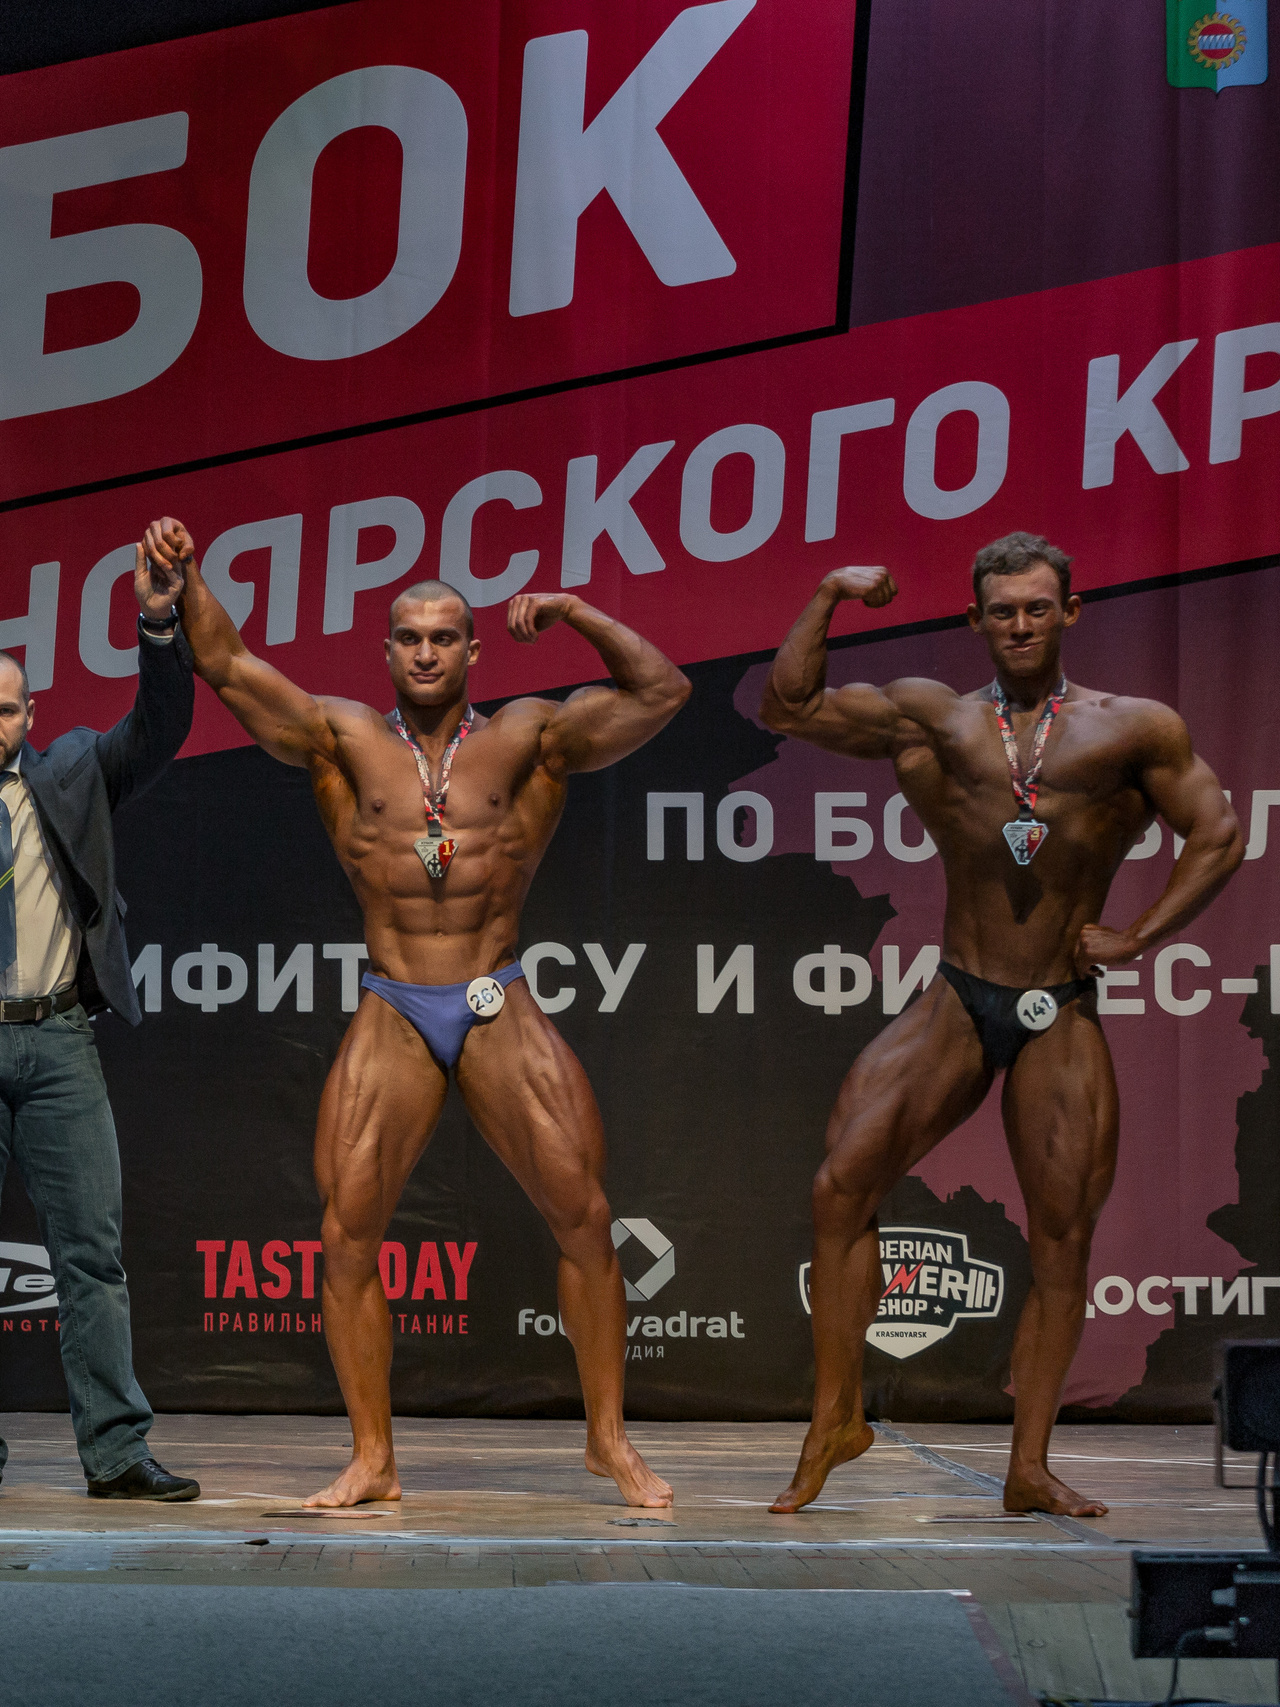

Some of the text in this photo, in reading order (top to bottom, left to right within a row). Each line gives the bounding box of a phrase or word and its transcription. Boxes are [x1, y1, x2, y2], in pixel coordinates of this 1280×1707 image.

[647, 790, 774, 862] ПО
[697, 944, 755, 1014] И
[470, 982, 503, 1012] 261
[1023, 996, 1053, 1023] 141
[877, 1298, 928, 1316] SHOP
[1085, 1275, 1280, 1319] ОСТИГ
[203, 1312, 469, 1335] ПРАВИЛЬН ТАНИЕ
[875, 1331, 928, 1339] KRASNOYARSK
